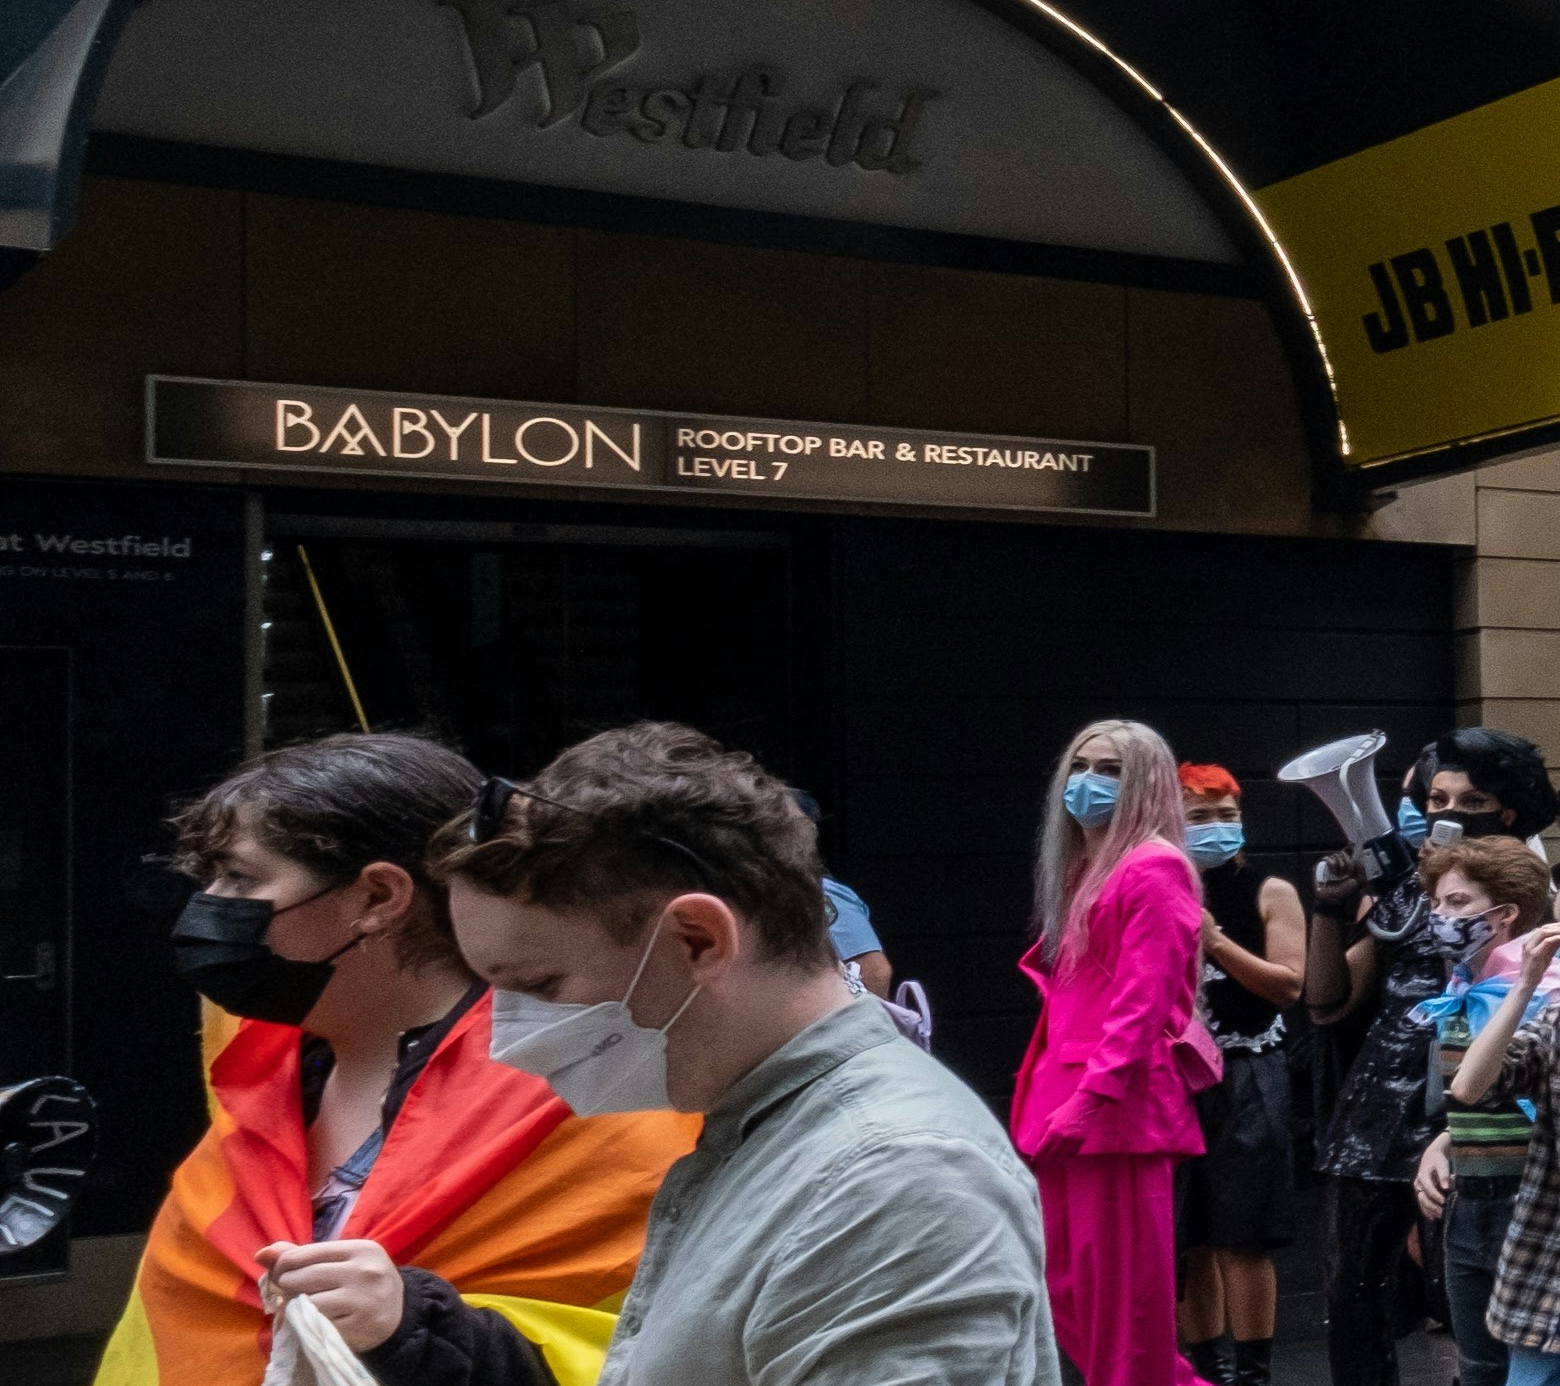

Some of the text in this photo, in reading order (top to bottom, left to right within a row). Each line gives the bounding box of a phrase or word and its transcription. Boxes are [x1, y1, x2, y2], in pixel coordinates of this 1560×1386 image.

[1361, 247, 1455, 355] JB
[275, 399, 641, 472] BABYLON
[677, 428, 1094, 473] ROOFTOP BAR & RESTAURANT
[677, 456, 788, 481] LEVEL 7
[34, 533, 192, 558] Westfield
